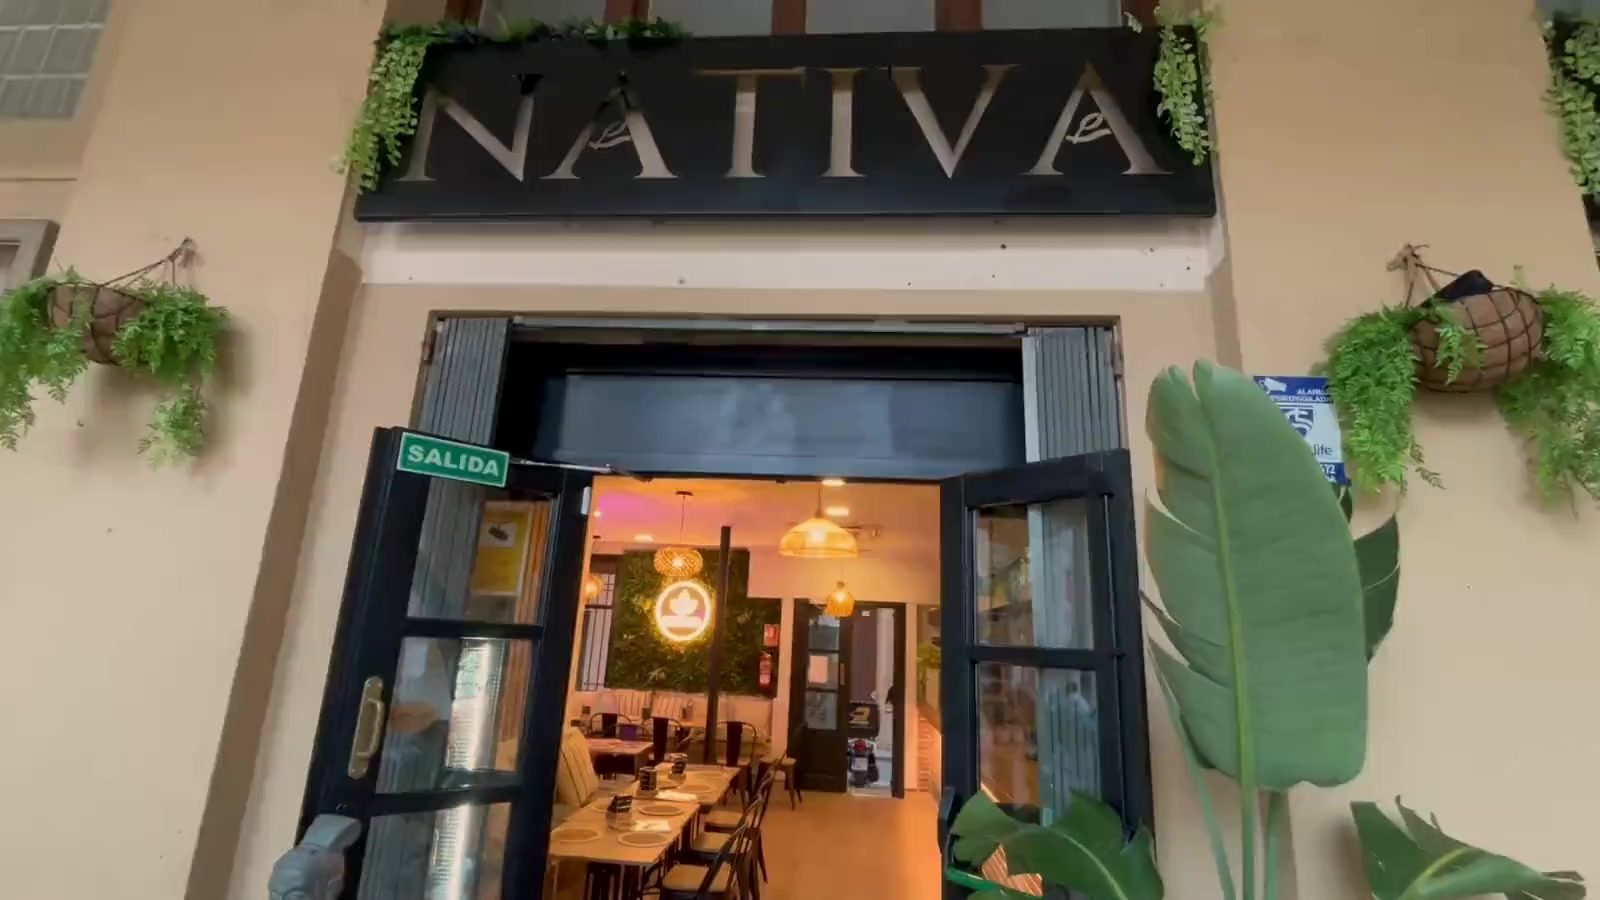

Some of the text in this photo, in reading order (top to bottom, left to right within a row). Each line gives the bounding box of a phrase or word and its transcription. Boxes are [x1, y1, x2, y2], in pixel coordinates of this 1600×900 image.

[393, 63, 1175, 181] NATIVA
[407, 445, 499, 477] SALIDA
[1312, 443, 1333, 456] life
